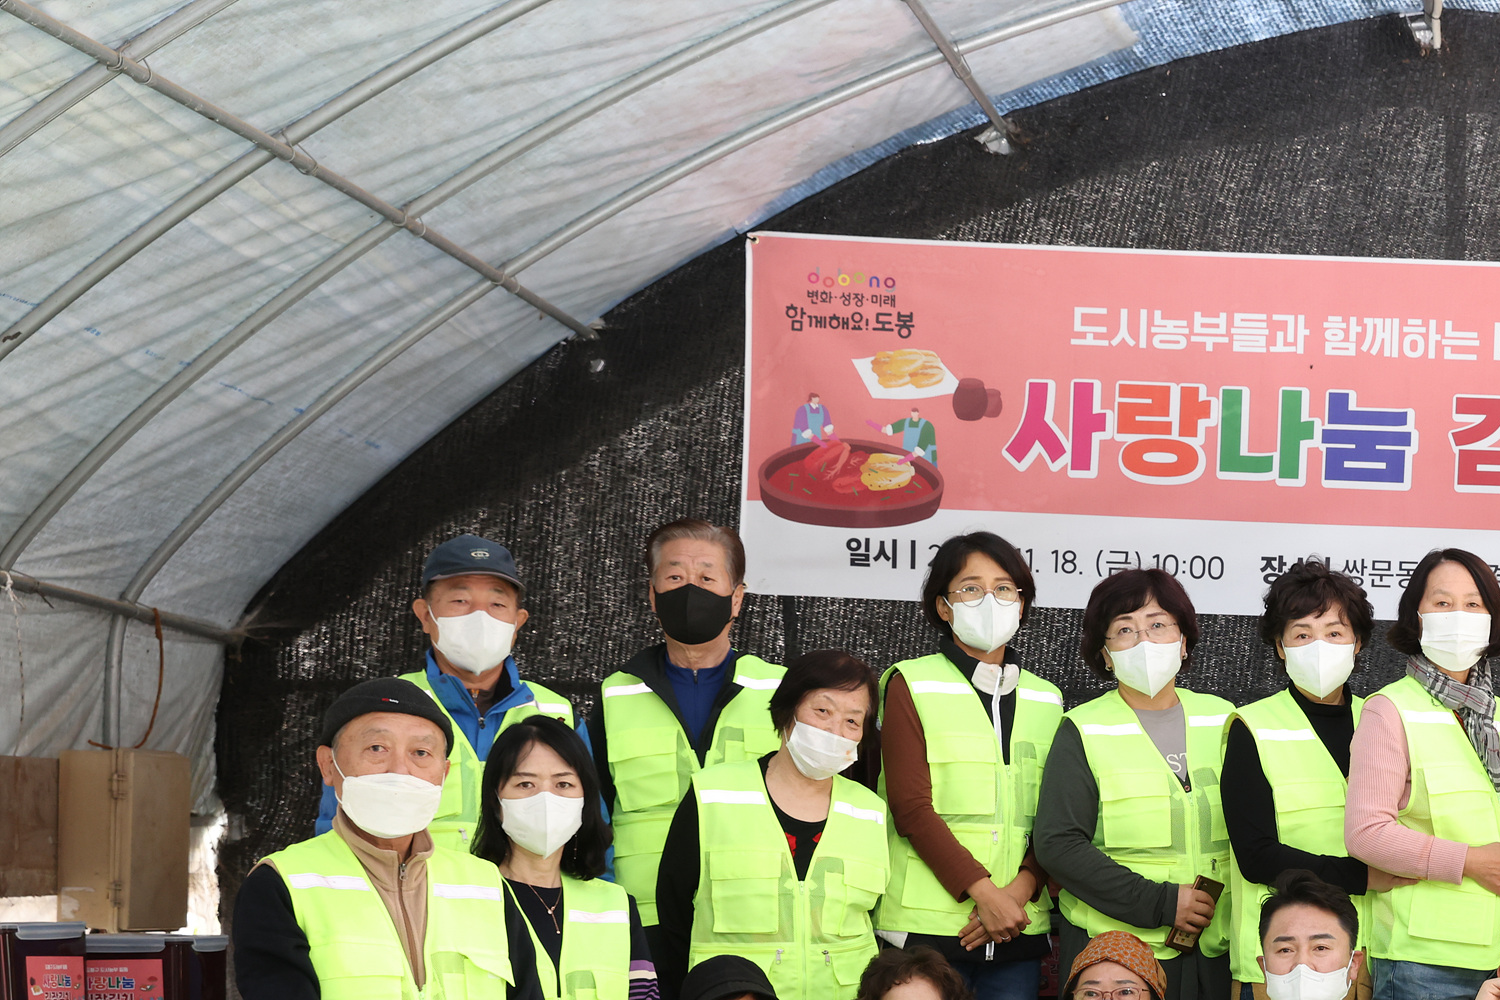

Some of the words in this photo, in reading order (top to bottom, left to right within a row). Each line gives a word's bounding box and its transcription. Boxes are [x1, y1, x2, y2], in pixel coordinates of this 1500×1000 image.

[785, 303, 869, 332] 함께해요!
[872, 311, 915, 339] 도봉
[1070, 306, 1310, 355] 도시농부들과
[1323, 314, 1480, 362] 함께하는
[1002, 379, 1418, 490] 사랑나눔
[845, 537, 898, 570] 일시
[1050, 549, 1083, 575] 18.
[1152, 553, 1225, 580] 10:00
